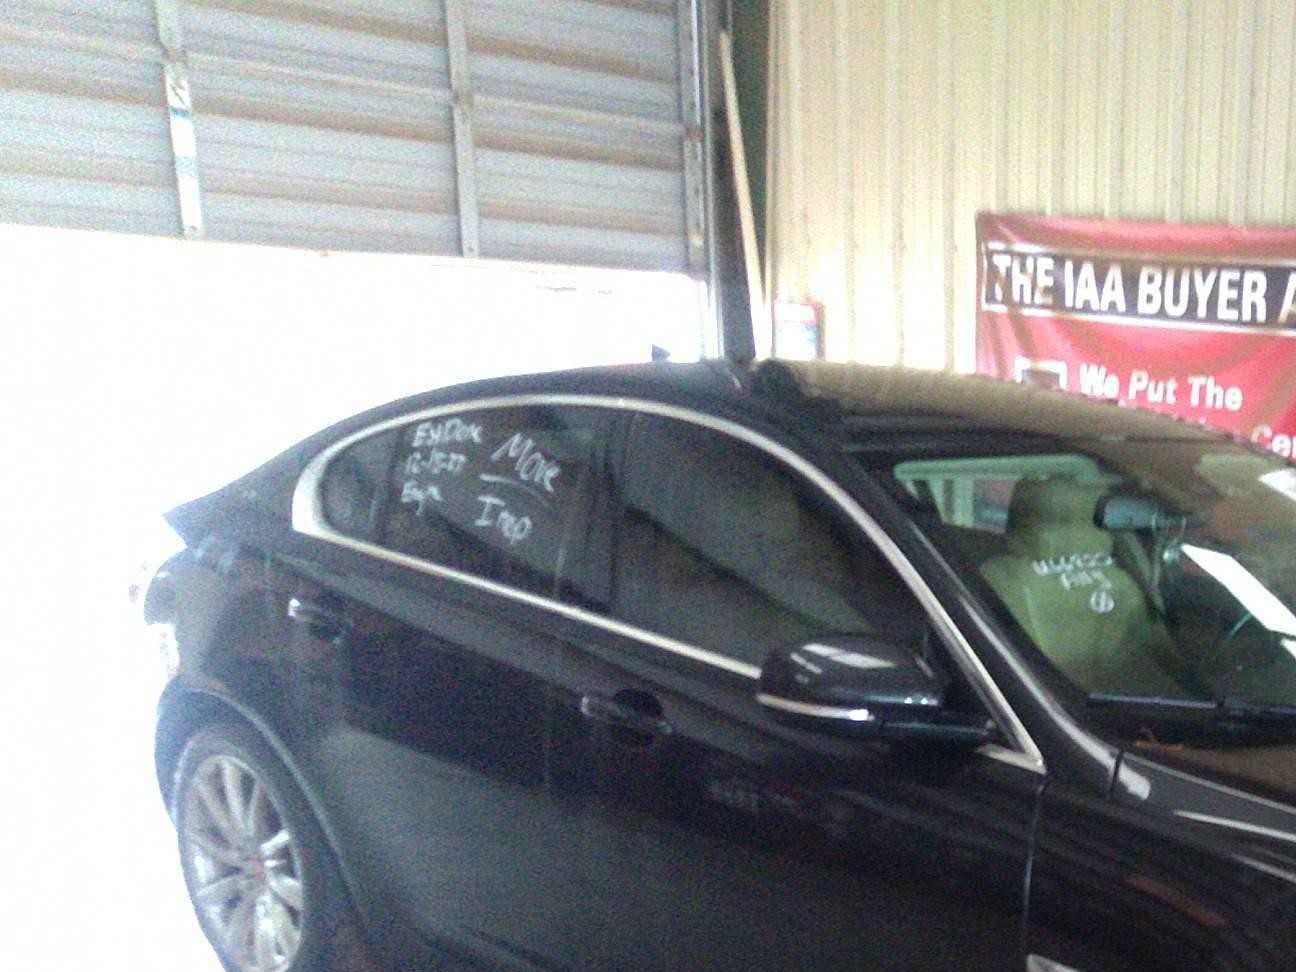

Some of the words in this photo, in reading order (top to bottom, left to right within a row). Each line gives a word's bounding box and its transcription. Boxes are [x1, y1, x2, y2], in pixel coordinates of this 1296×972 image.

[992, 253, 1054, 306] THE
[1063, 260, 1126, 313] IAA
[1137, 265, 1267, 324] BUYER
[1079, 363, 1120, 400] We
[1128, 369, 1178, 402] Put
[1188, 375, 1243, 411] The
